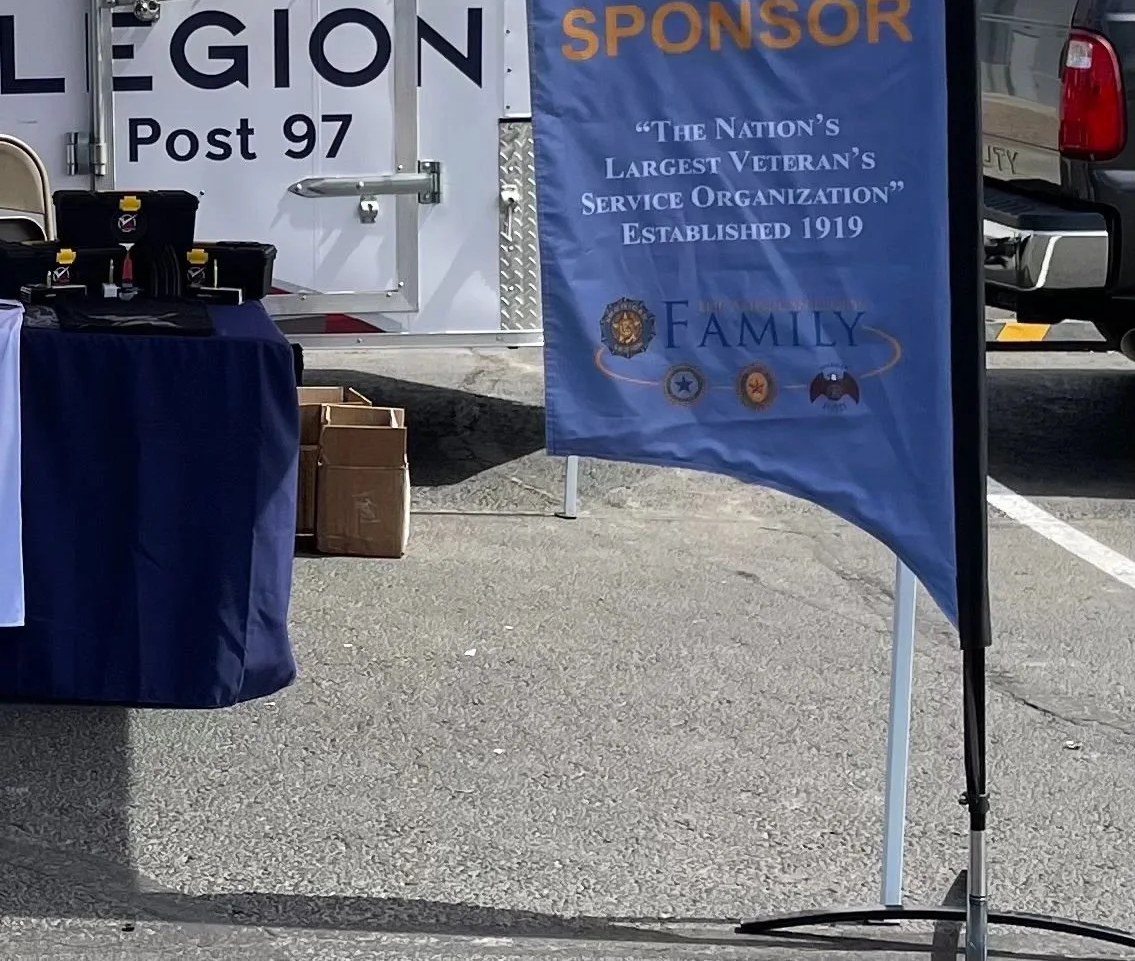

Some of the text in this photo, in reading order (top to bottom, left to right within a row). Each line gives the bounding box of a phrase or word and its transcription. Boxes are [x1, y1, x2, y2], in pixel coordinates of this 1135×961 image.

[128, 113, 353, 162] Post 97
[635, 113, 840, 144] "THE NATION'S
[604, 146, 875, 179] LARGEST VETERAN'S
[581, 180, 905, 216] SERVICE ORGANIZATION"
[621, 215, 863, 246] ESTABLISHED 1919
[663, 299, 867, 348] FAMILY
